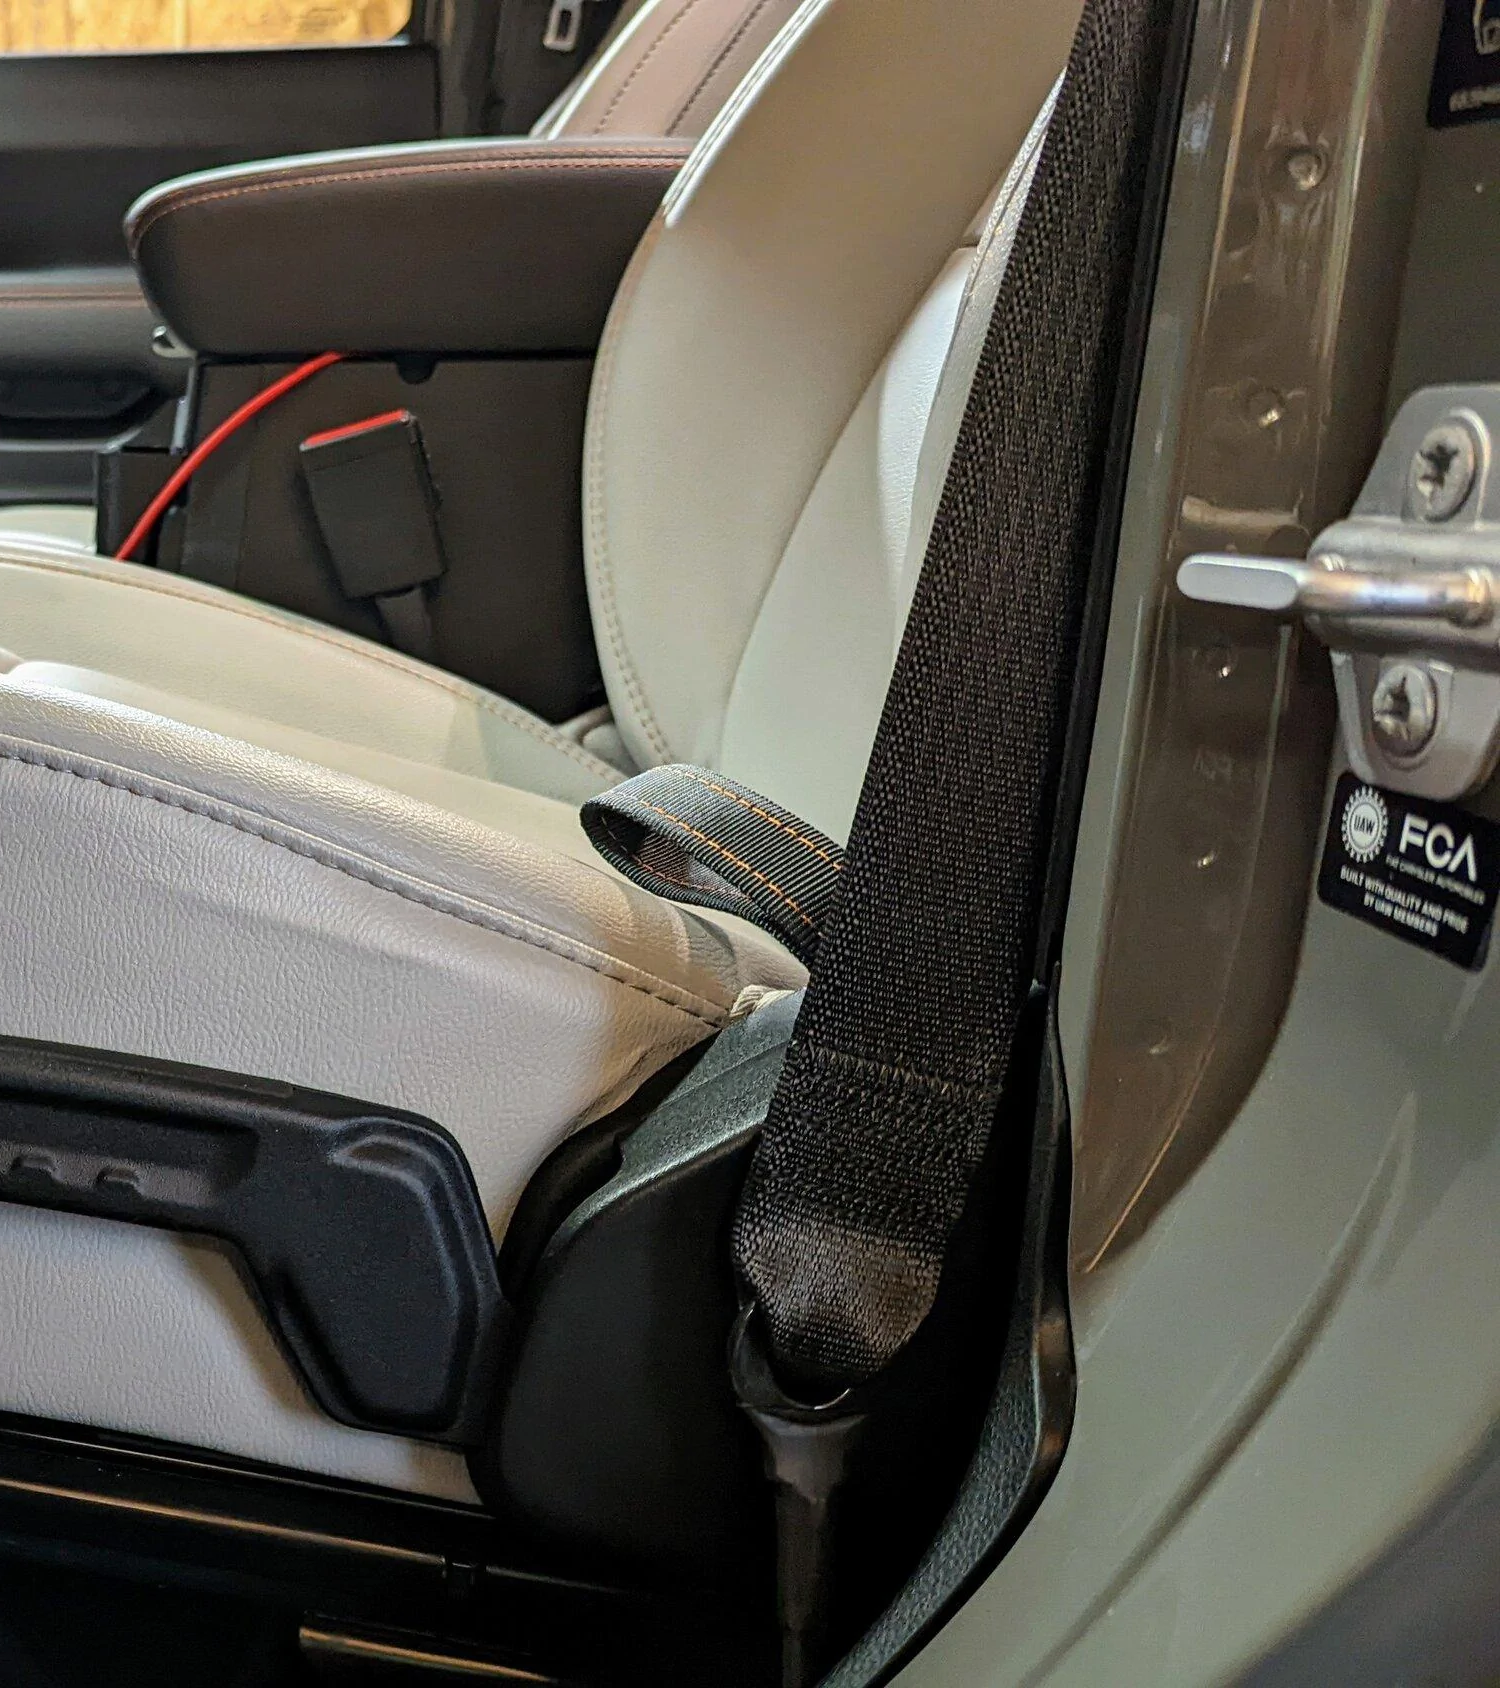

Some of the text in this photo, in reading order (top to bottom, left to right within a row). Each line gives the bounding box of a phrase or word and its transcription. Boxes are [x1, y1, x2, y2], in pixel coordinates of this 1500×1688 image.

[1353, 815, 1375, 836] UAW
[1399, 812, 1477, 882] FCA
[1340, 864, 1365, 887] BUILT
[1364, 875, 1385, 896] WITH
[1384, 884, 1421, 912] QUALITY
[1421, 900, 1443, 921] AND
[1364, 891, 1439, 937] BY UAW MEMBERS
